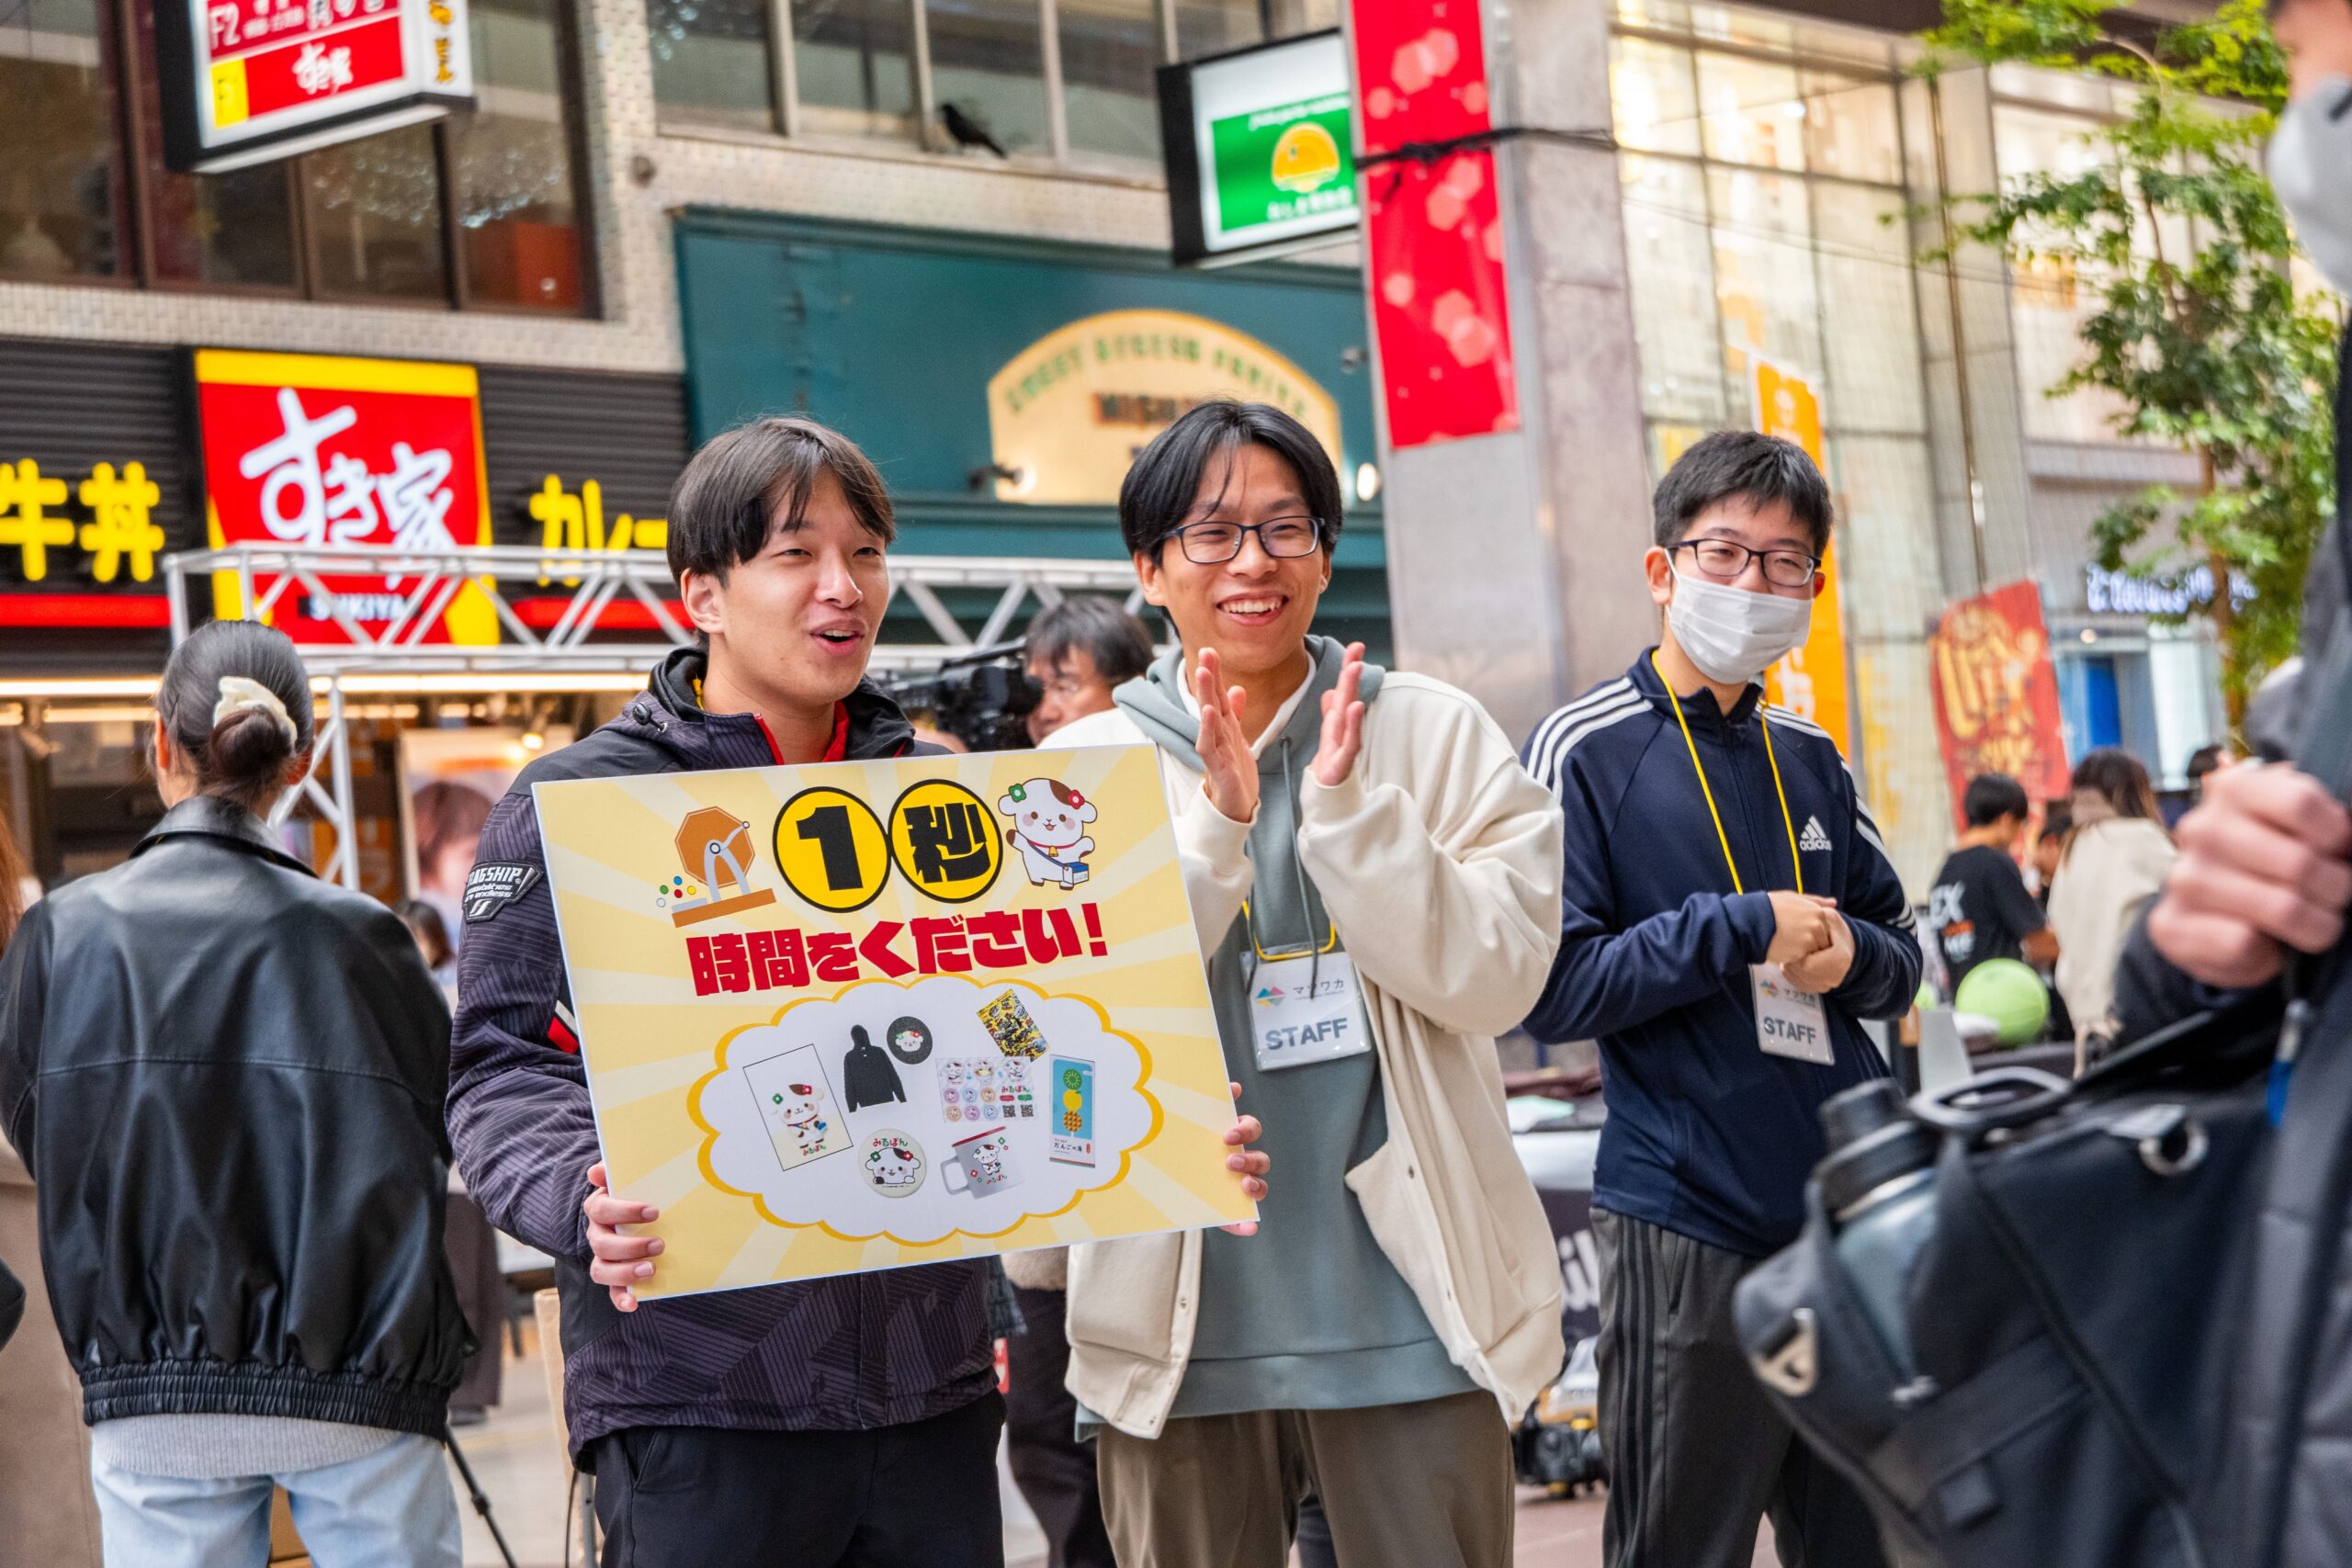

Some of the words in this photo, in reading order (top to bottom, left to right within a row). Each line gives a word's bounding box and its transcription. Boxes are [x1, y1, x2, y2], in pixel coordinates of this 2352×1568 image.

[0, 457, 166, 583] 牛丼
[239, 387, 459, 590] すき家
[685, 902, 1108, 998] 時間をください!
[1265, 1017, 1348, 1051] STAFF
[1763, 1016, 1816, 1045] STAFF
